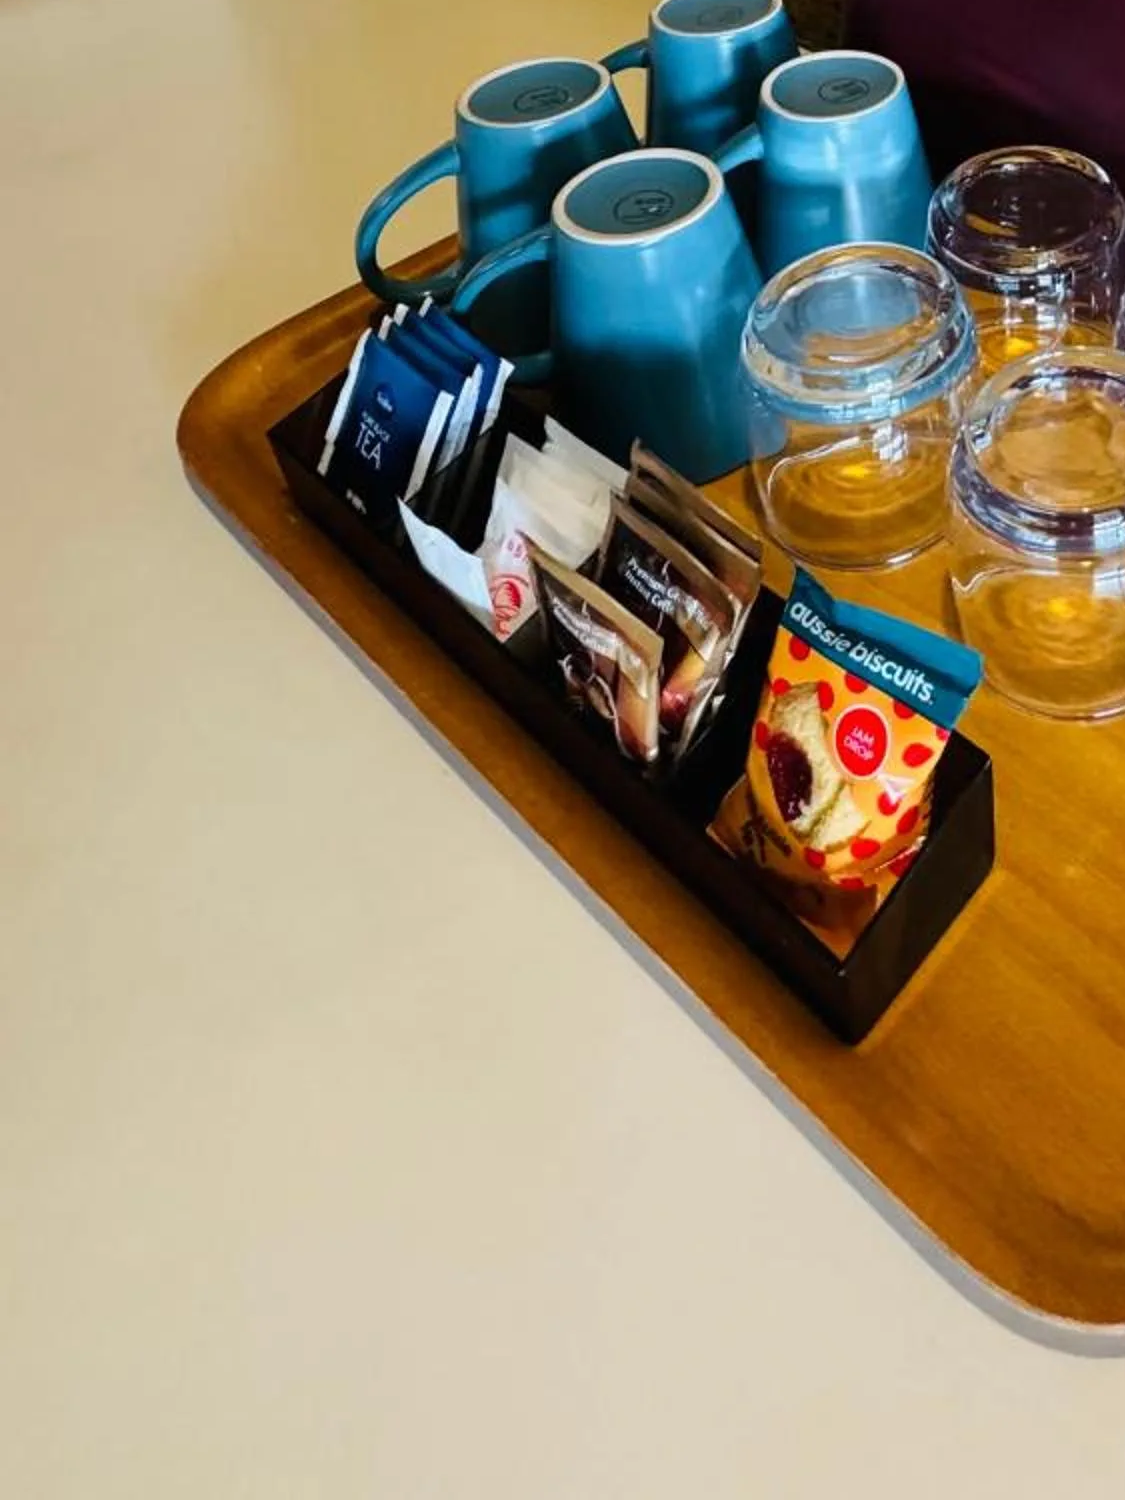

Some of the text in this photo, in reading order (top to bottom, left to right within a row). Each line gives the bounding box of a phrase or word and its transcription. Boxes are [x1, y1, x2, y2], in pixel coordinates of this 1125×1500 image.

[354, 420, 382, 471] TEA
[788, 601, 935, 707] aussie biscuits.
[842, 734, 876, 762] DROP
[850, 725, 876, 749] JAM
